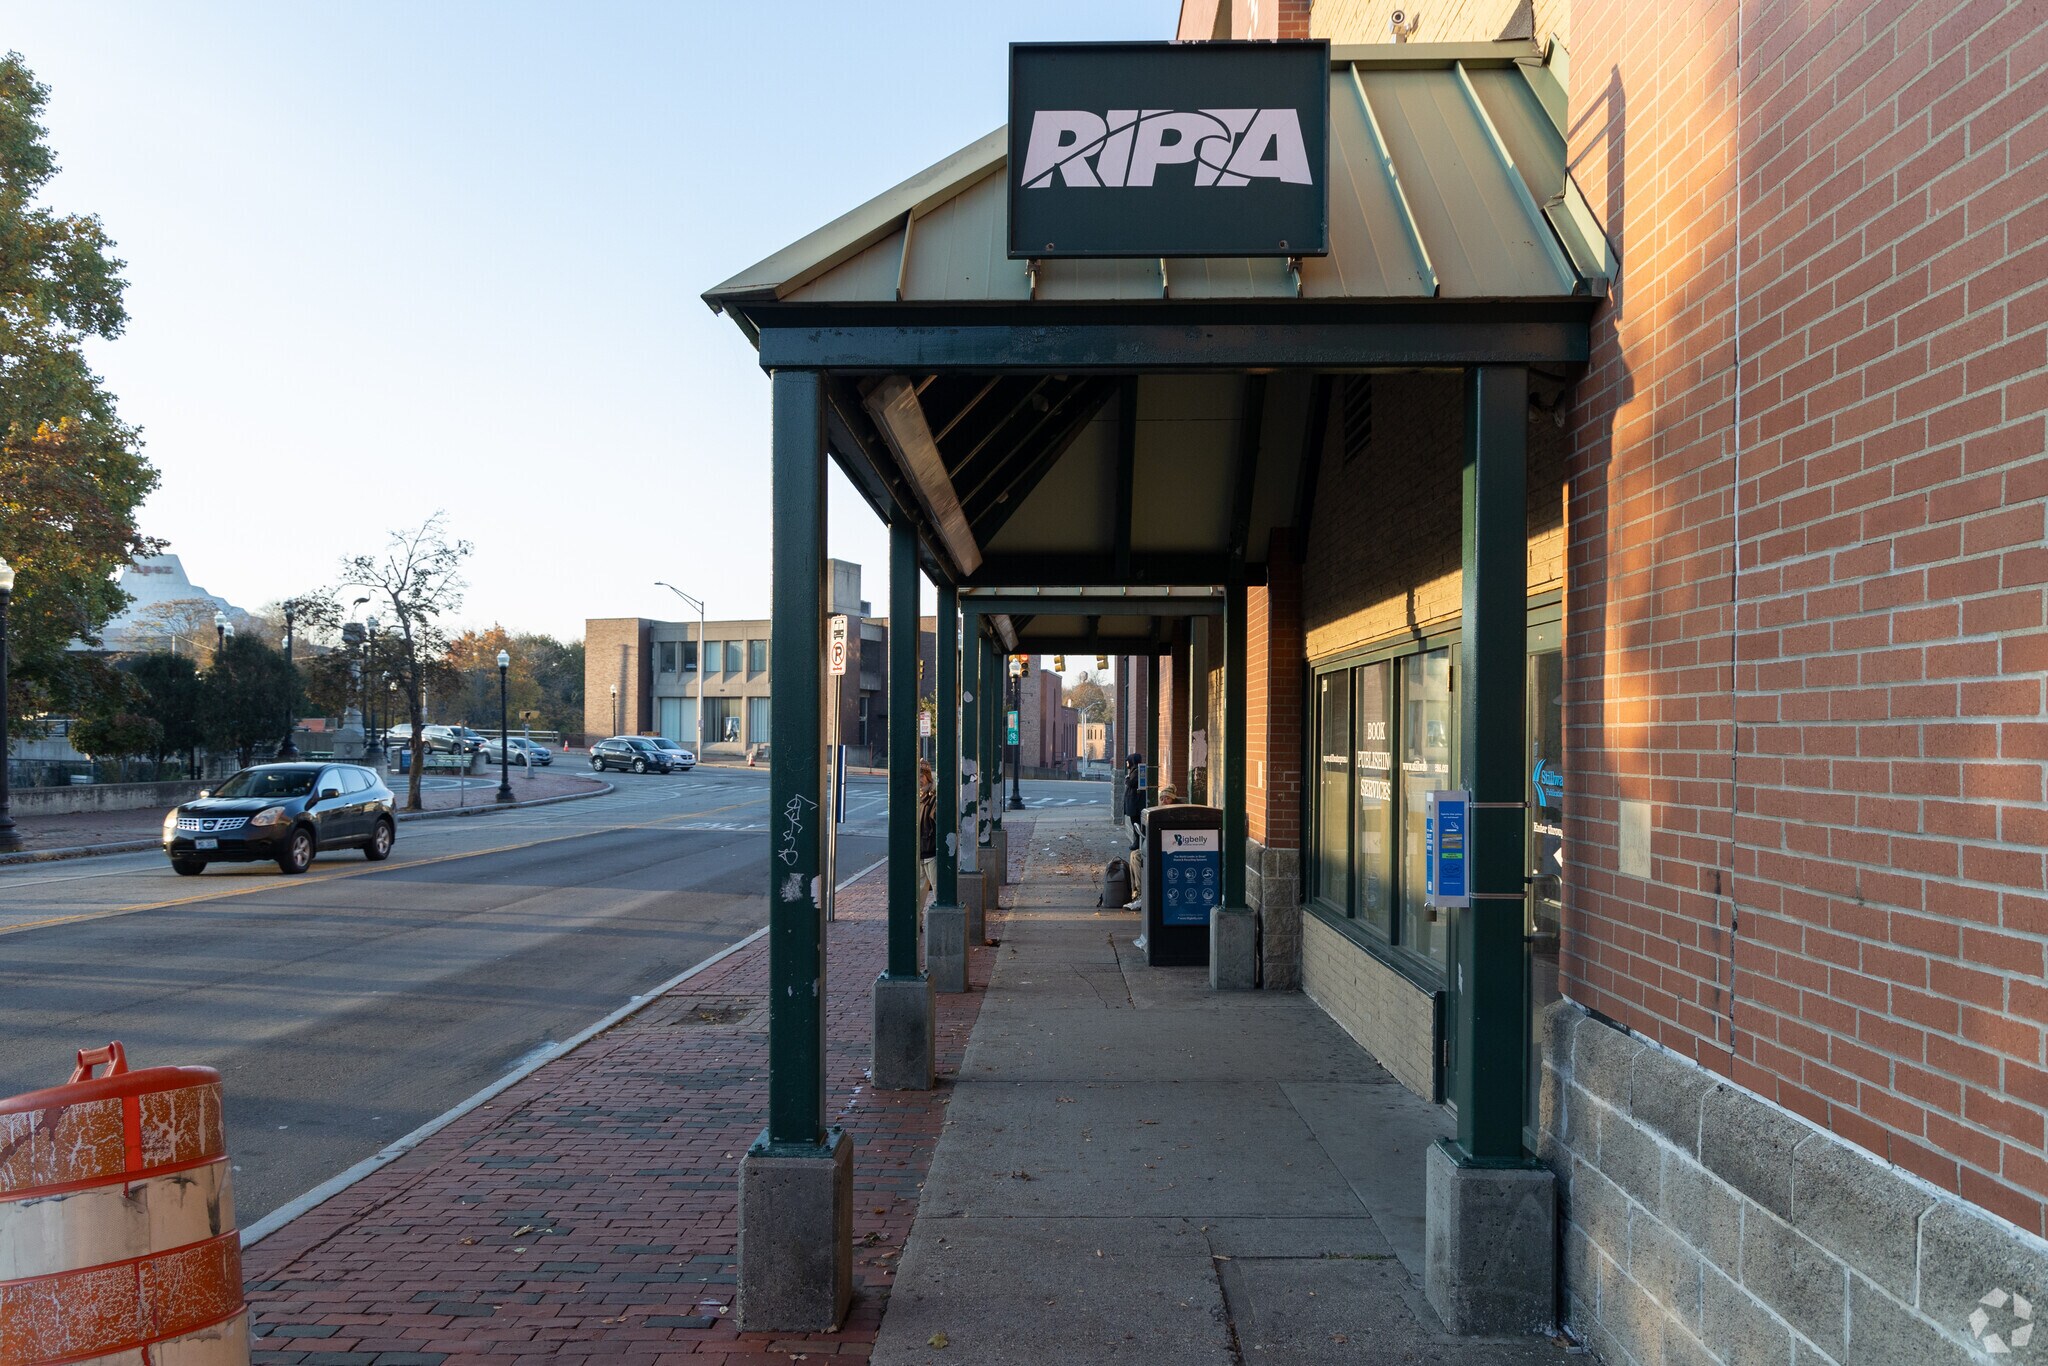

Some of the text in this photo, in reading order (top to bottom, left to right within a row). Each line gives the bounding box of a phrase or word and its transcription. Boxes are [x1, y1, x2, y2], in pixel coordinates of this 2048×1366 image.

[1021, 108, 1313, 189] RIPTA
[1367, 721, 1386, 740] BOOK
[1360, 778, 1391, 801] SERVICES
[1533, 821, 1547, 834] Enter
[1174, 834, 1208, 847] Bigbelly
